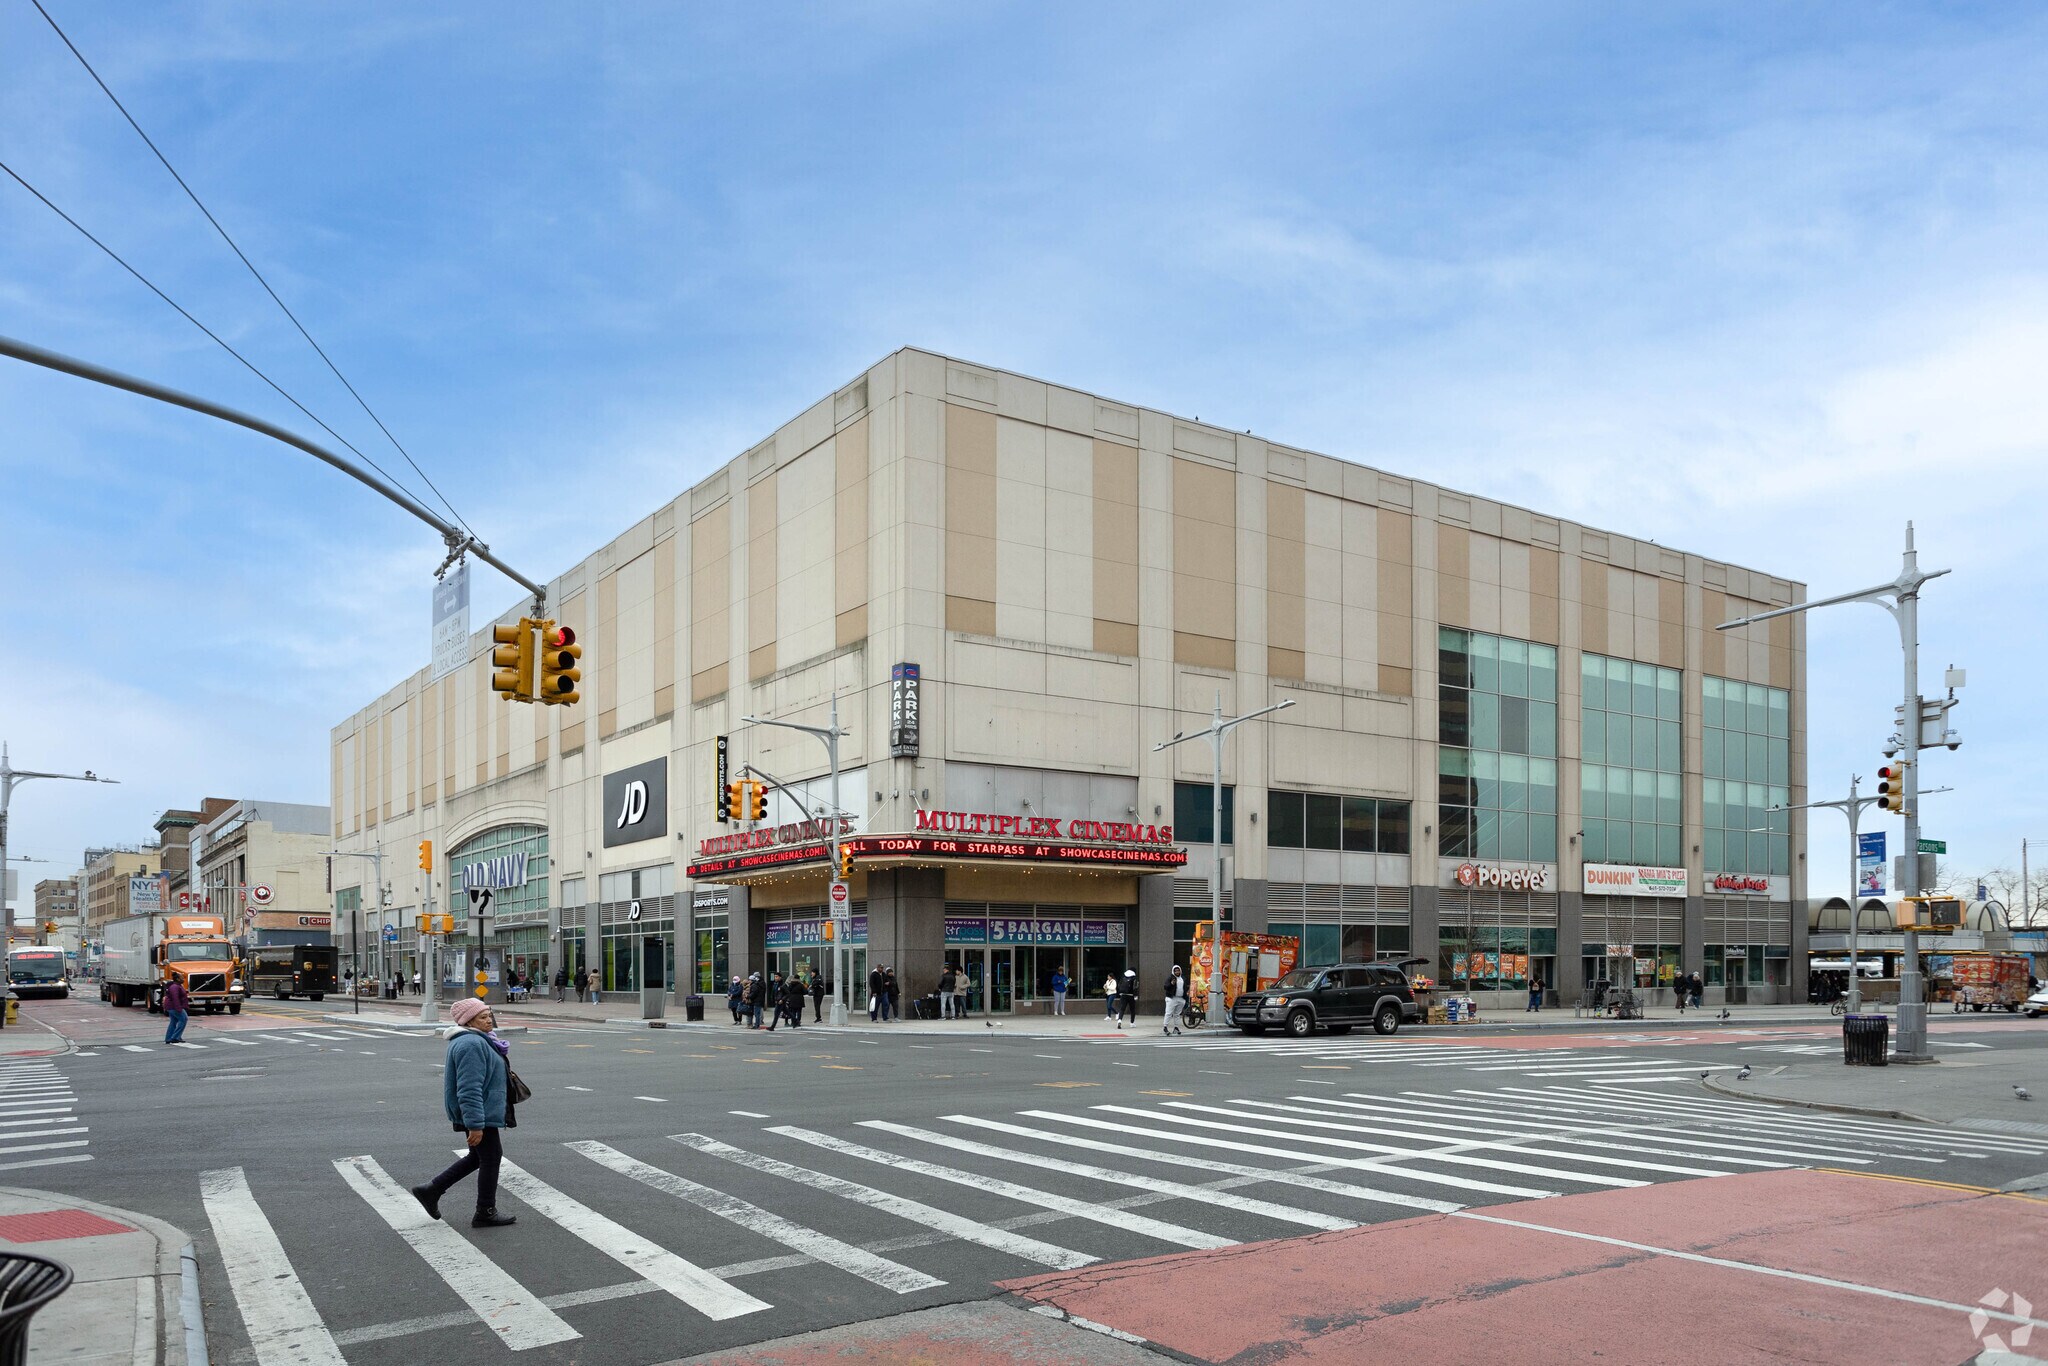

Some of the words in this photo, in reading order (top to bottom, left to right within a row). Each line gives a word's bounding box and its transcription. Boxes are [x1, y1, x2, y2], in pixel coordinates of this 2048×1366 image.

[451, 646, 468, 666] ACCESS
[893, 680, 902, 720] PARK
[905, 680, 917, 720] PARK
[617, 780, 648, 829] JD
[915, 809, 1063, 837] MULTIPLEX
[1068, 819, 1173, 844] CINEMAS
[700, 827, 774, 856] MULTIPLEX
[778, 818, 849, 844] CINEMAS
[879, 840, 922, 850] TODAY
[933, 842, 956, 851] FOR
[967, 843, 1025, 855] STARPASS
[1036, 847, 1050, 856] AT
[462, 862, 487, 894] OLD
[489, 852, 527, 888] NAVY
[700, 861, 724, 873] DETAILS
[728, 860, 736, 869] AT
[1671, 871, 1686, 880] PIZZA
[1588, 870, 1635, 885] DUNKIN'
[628, 901, 641, 920] JD
[693, 898, 729, 908] JDSPORTS.COM
[990, 920, 1005, 940] $5
[1008, 921, 1080, 934] BARGAIN
